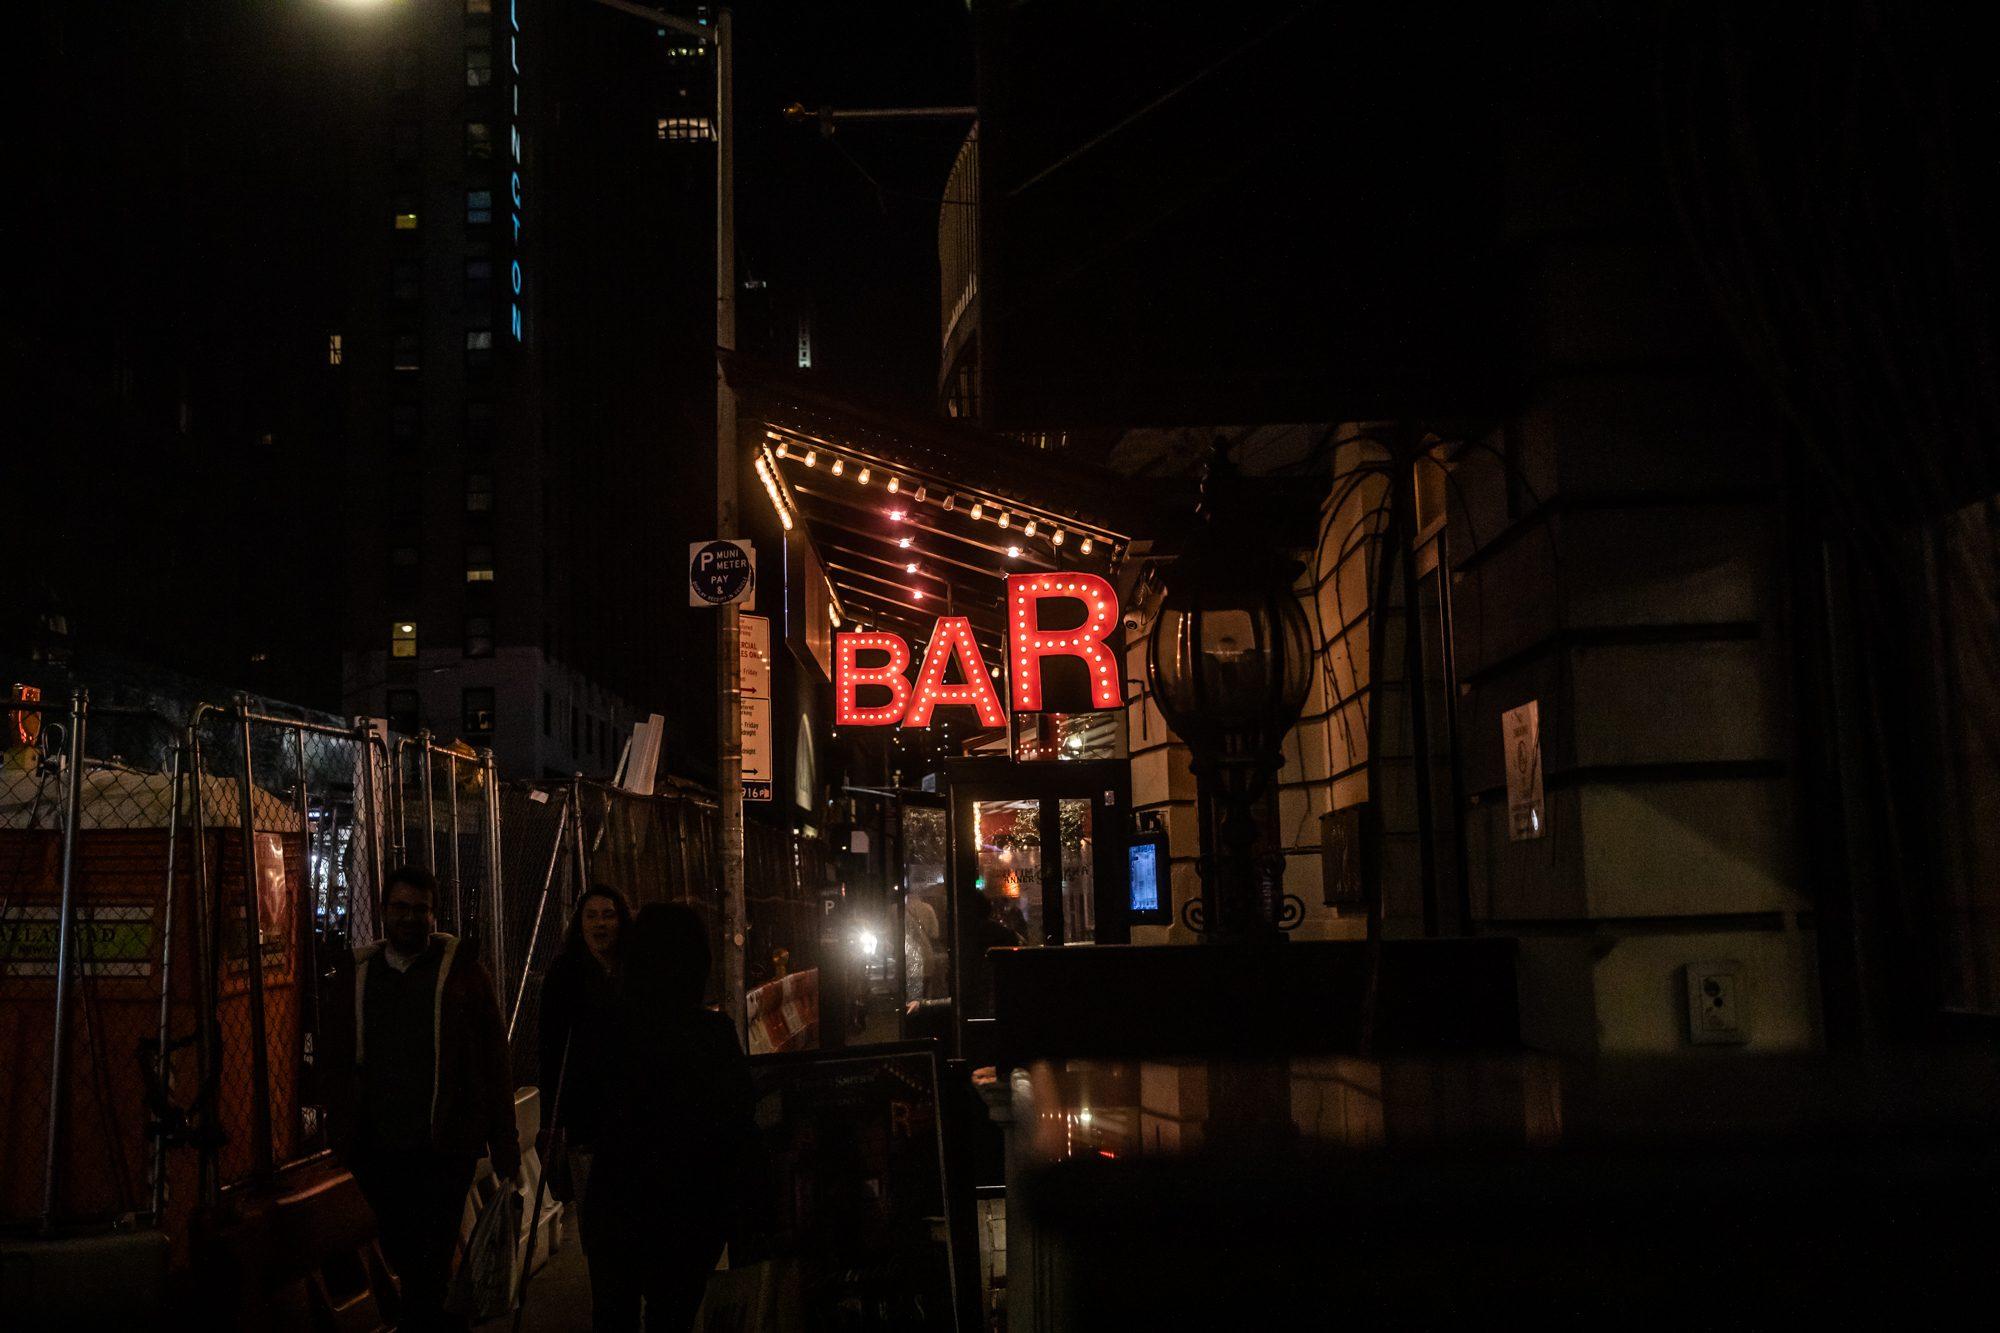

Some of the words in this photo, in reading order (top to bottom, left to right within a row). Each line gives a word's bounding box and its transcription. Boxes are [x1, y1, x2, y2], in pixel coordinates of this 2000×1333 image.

[701, 552, 713, 571] P
[717, 549, 738, 559] MUNI
[717, 560, 746, 570] METER
[711, 575, 728, 584] PAY
[717, 586, 723, 594] &
[741, 641, 757, 650] RCIAL
[836, 572, 1124, 727] BAR
